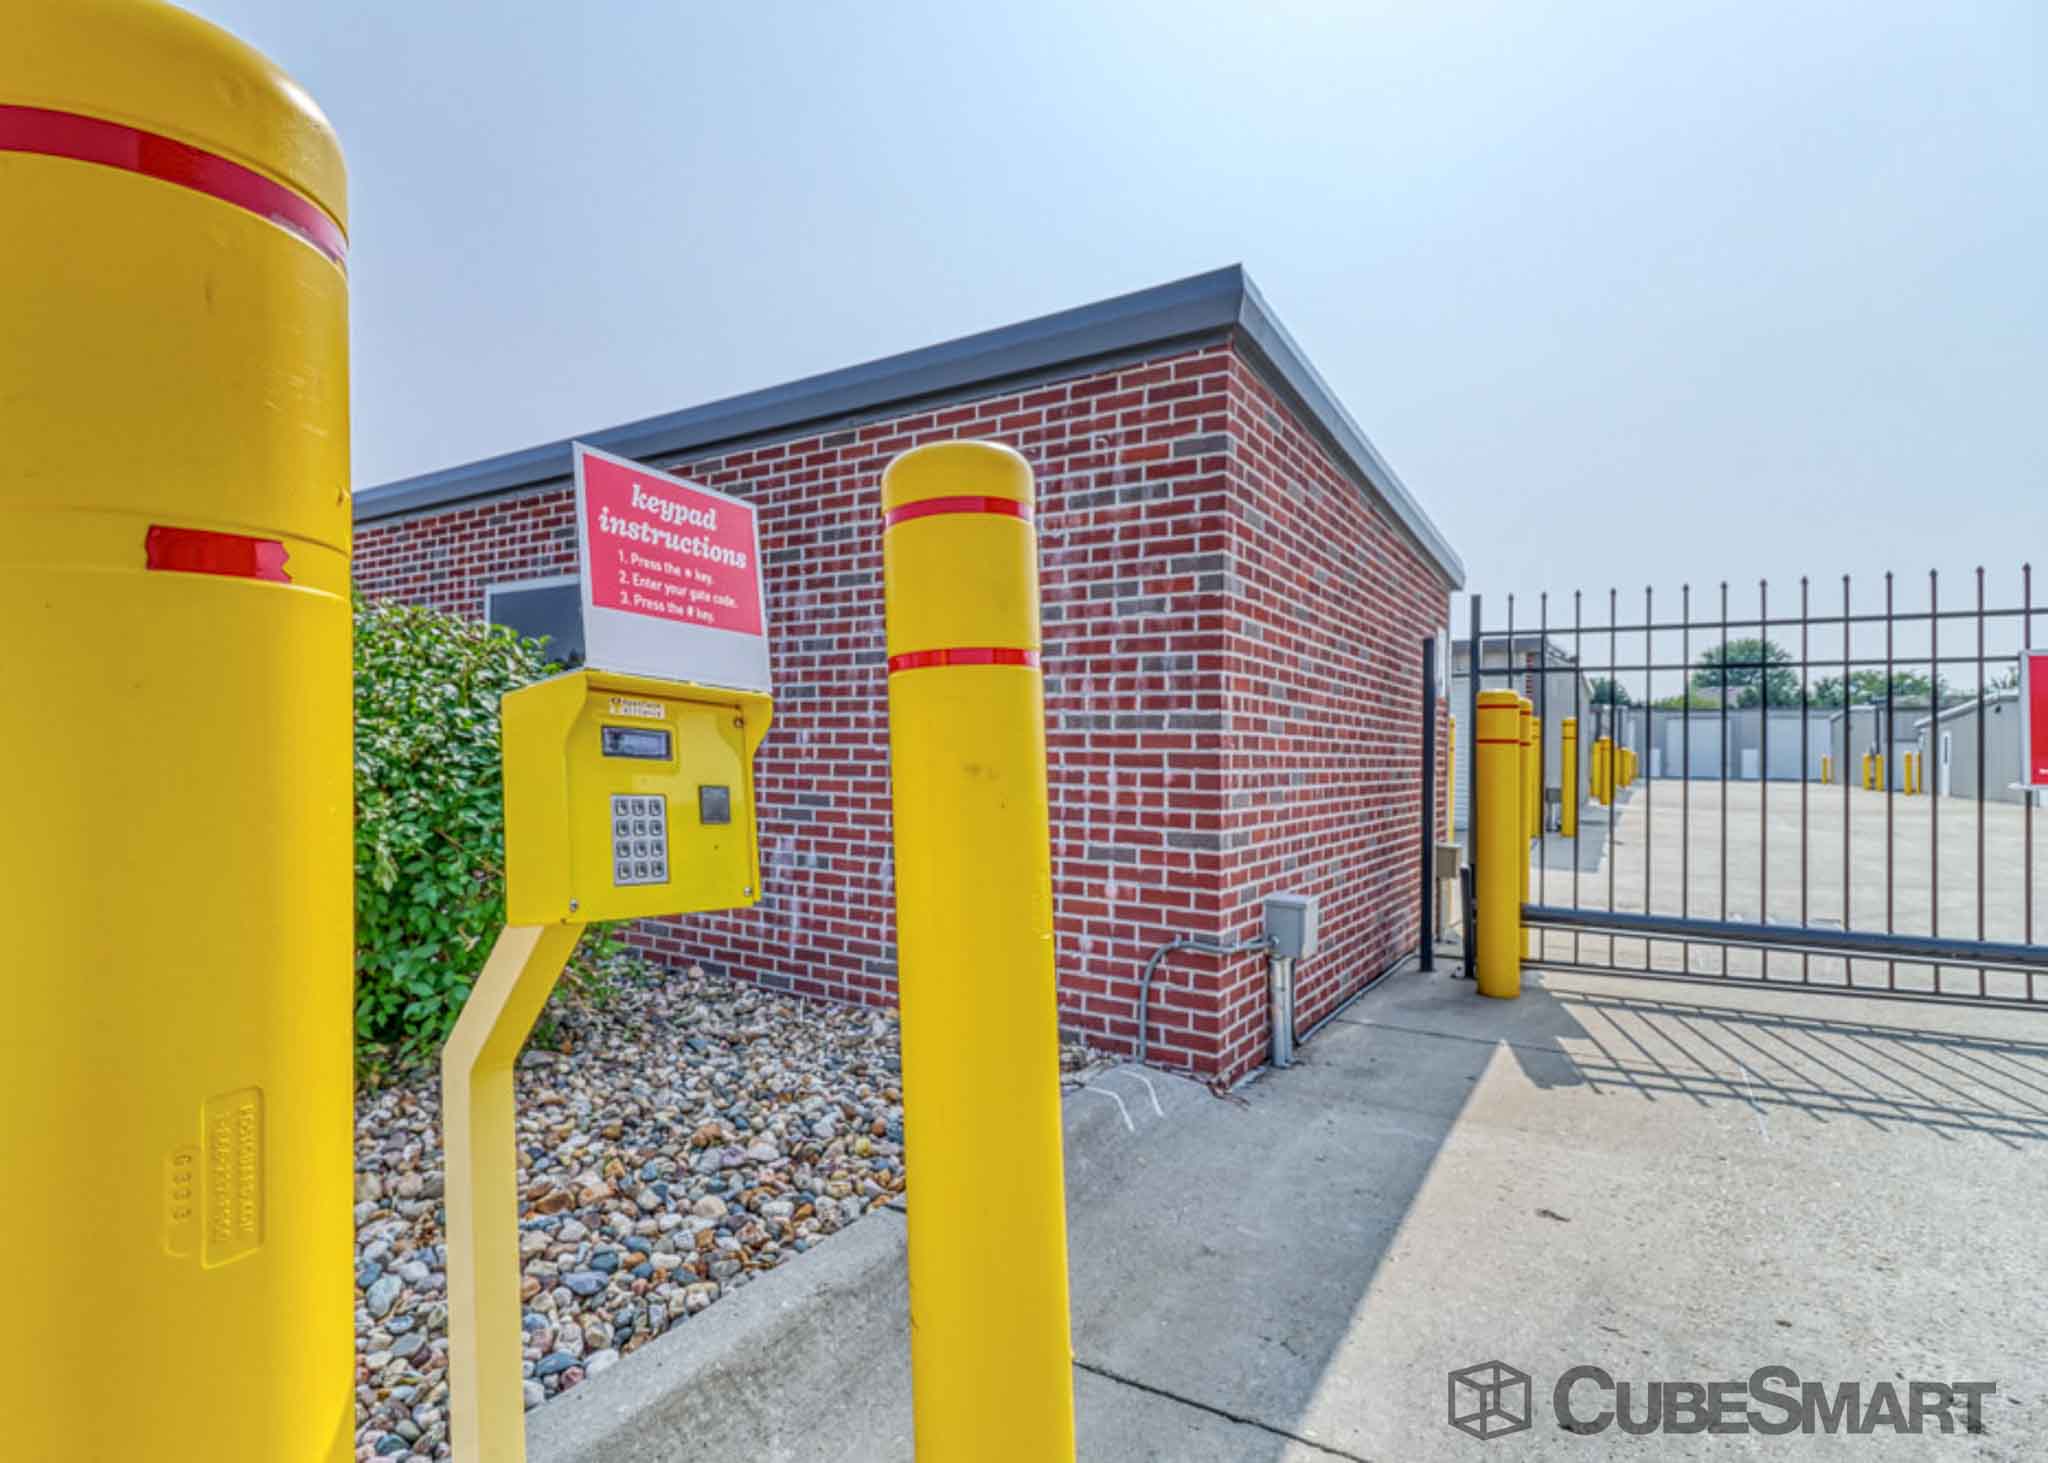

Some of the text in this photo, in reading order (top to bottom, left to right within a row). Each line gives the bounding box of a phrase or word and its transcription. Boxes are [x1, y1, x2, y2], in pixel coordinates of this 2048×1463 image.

[632, 484, 717, 530] keypad
[598, 507, 747, 568] instructions
[618, 549, 628, 565] 1.
[630, 552, 662, 572] Press
[663, 561, 681, 576] the
[618, 570, 630, 585] 2.
[632, 572, 662, 590] Enter
[664, 583, 687, 597] your
[690, 589, 711, 602] gate
[633, 593, 664, 612] Press
[667, 602, 684, 616] the
